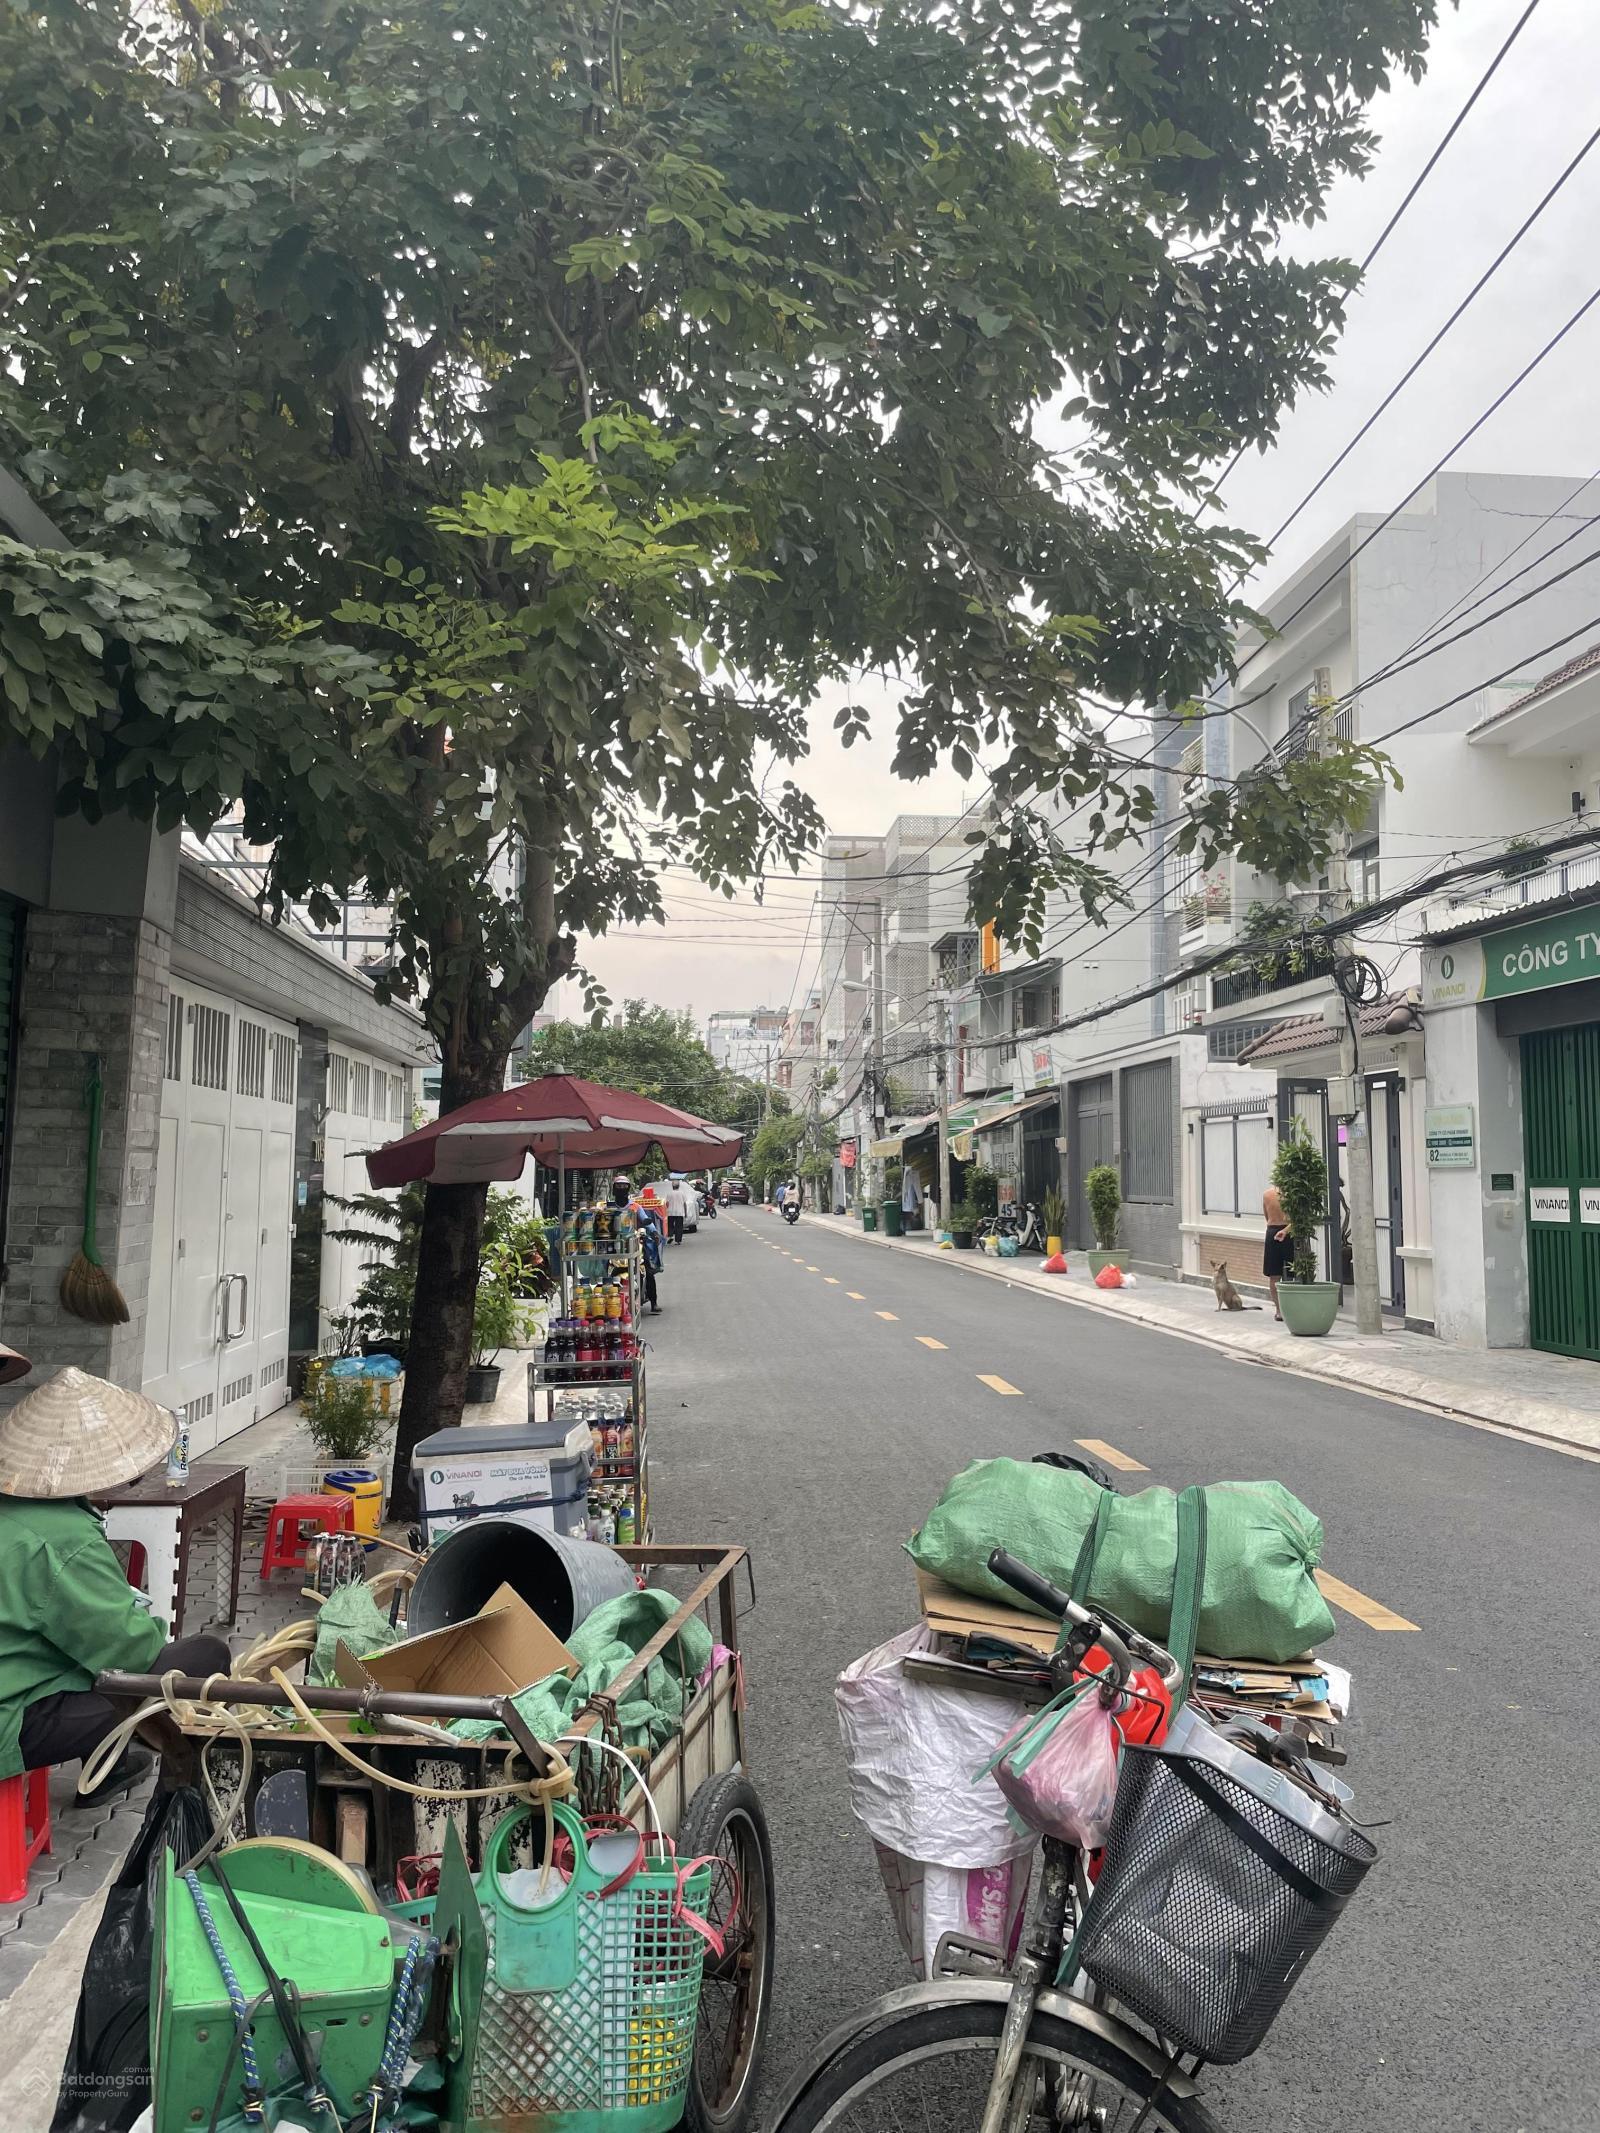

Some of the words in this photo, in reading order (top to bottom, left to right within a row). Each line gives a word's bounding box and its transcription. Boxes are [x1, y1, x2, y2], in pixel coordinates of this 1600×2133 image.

[1502, 940, 1568, 977] CÔNG
[1574, 932, 1600, 960] TY
[1429, 1149, 1439, 1161] 82
[1001, 1204, 1012, 1216] 45
